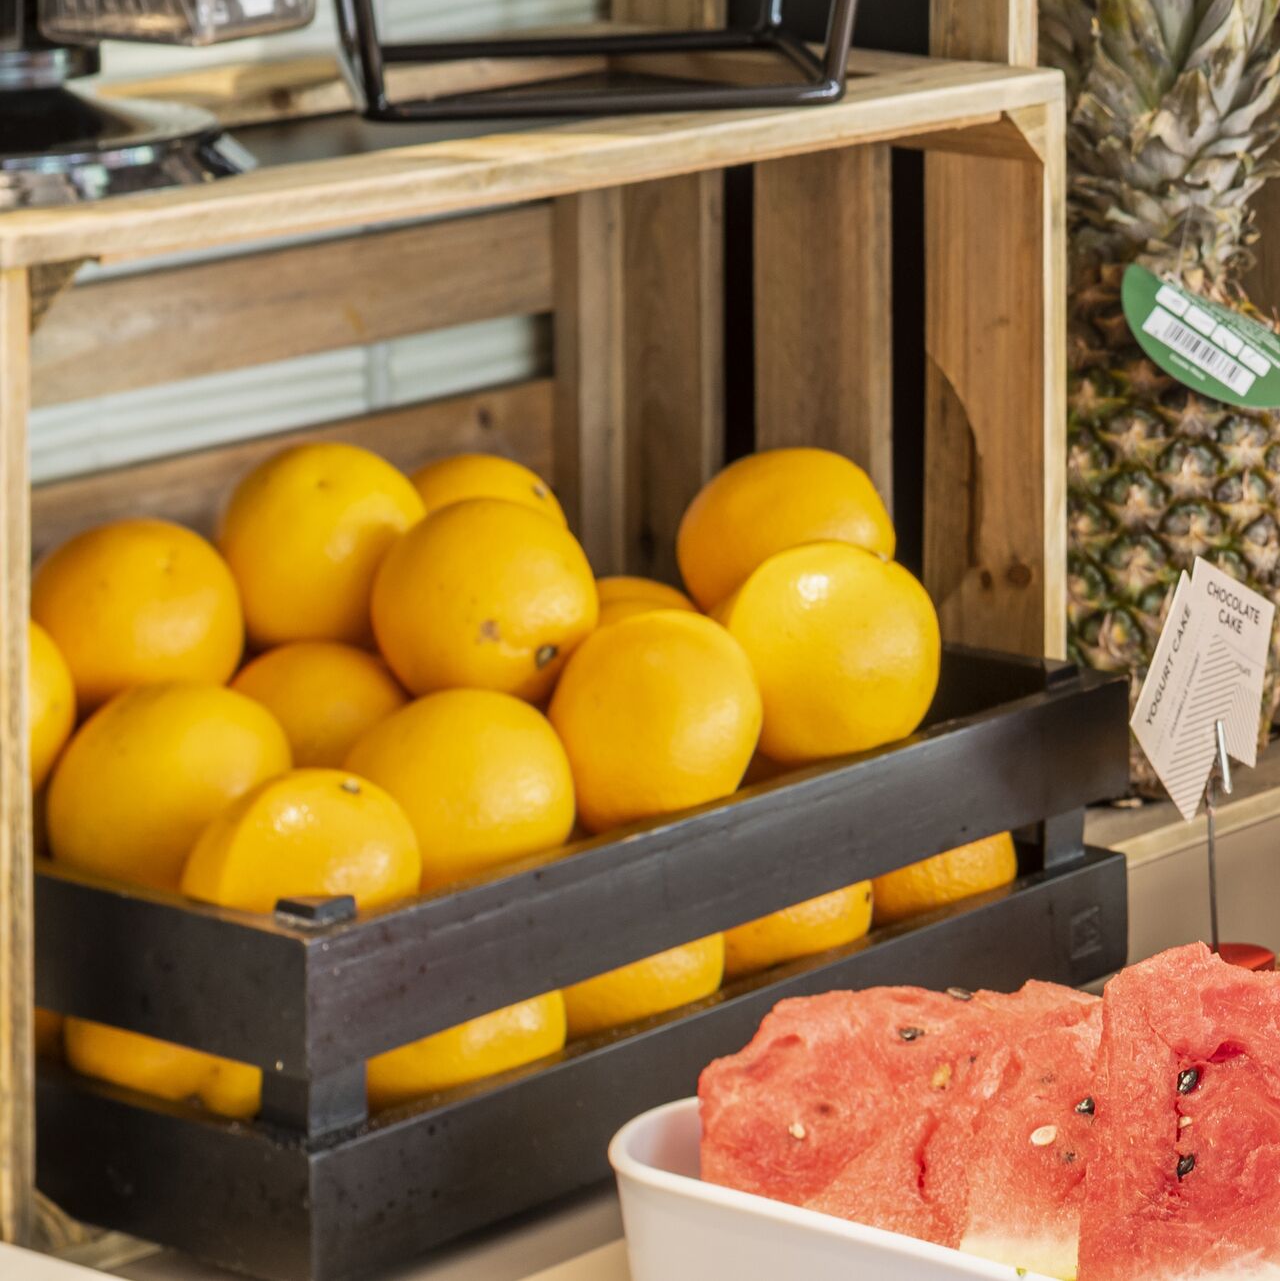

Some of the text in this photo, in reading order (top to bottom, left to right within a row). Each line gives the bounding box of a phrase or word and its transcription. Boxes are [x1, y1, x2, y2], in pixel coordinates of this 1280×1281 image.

[1207, 581, 1260, 625] CHOCOLATE
[1218, 609, 1243, 635] CAKE
[1146, 603, 1192, 726] YOGURT CAKE
